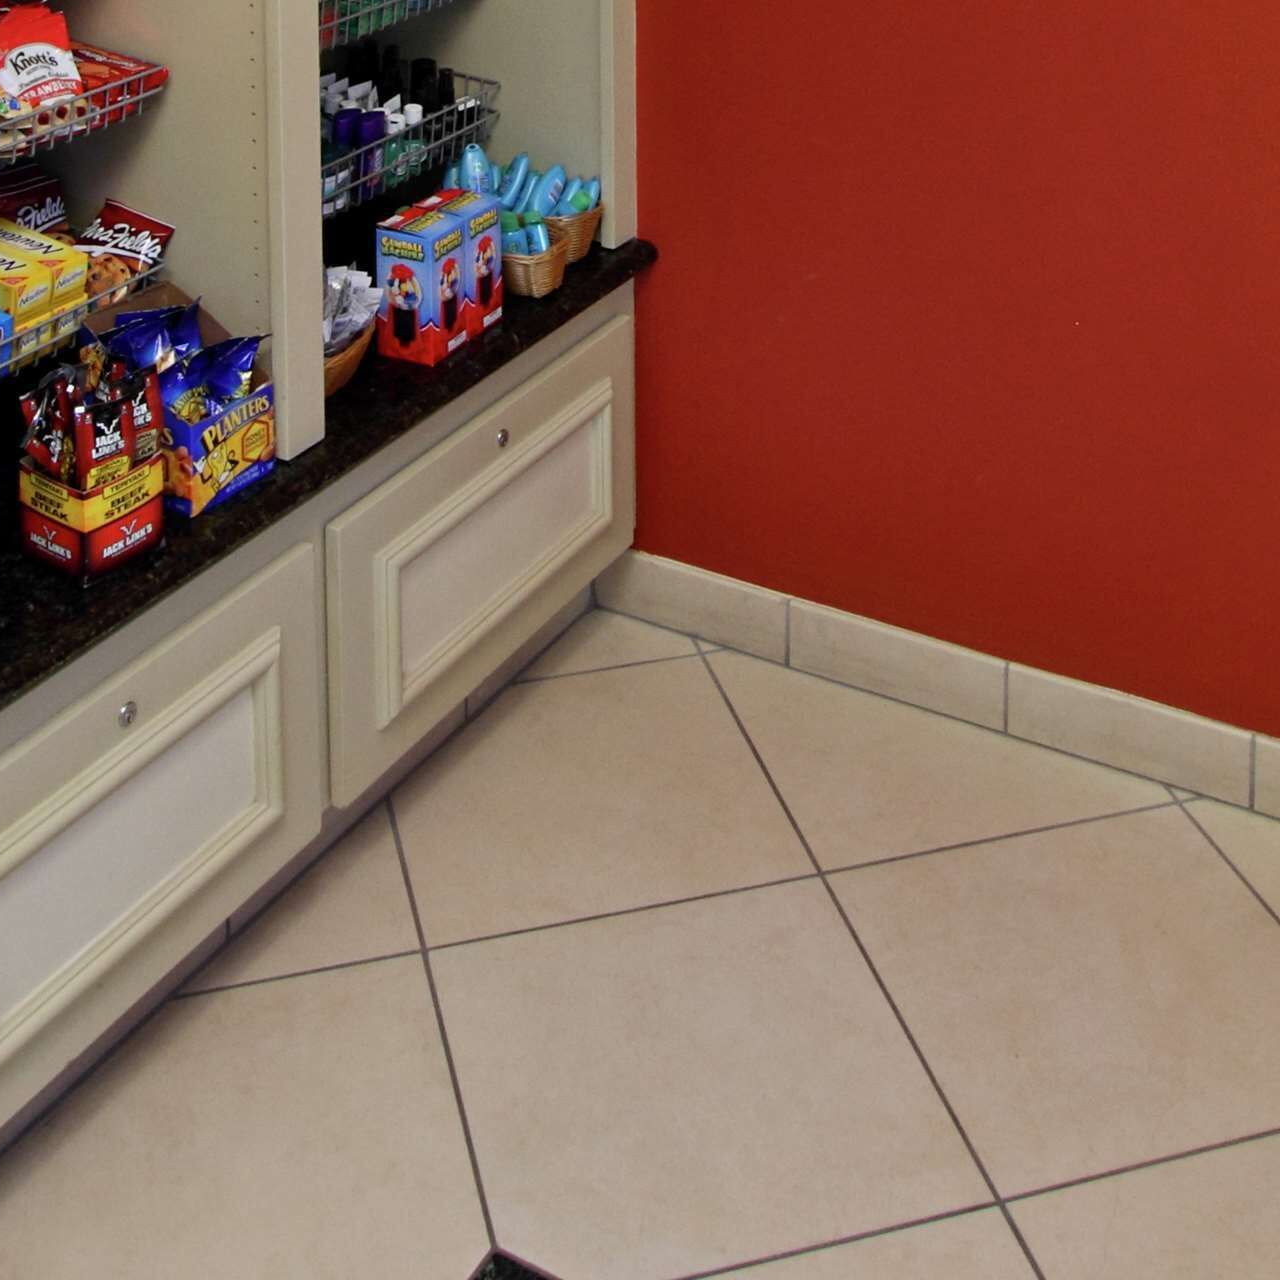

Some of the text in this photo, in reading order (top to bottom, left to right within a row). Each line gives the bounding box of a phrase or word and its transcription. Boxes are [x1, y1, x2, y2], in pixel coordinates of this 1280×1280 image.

[9, 50, 59, 76] Knott's
[104, 222, 162, 259] Fields
[202, 394, 270, 452] PLANTERS
[95, 431, 121, 449] JACK
[30, 496, 69, 523] STEAK
[33, 490, 65, 510] BEEF
[104, 490, 151, 520] STEAK
[110, 485, 146, 508] BEEF
[102, 522, 153, 559] JACK LINK'S
